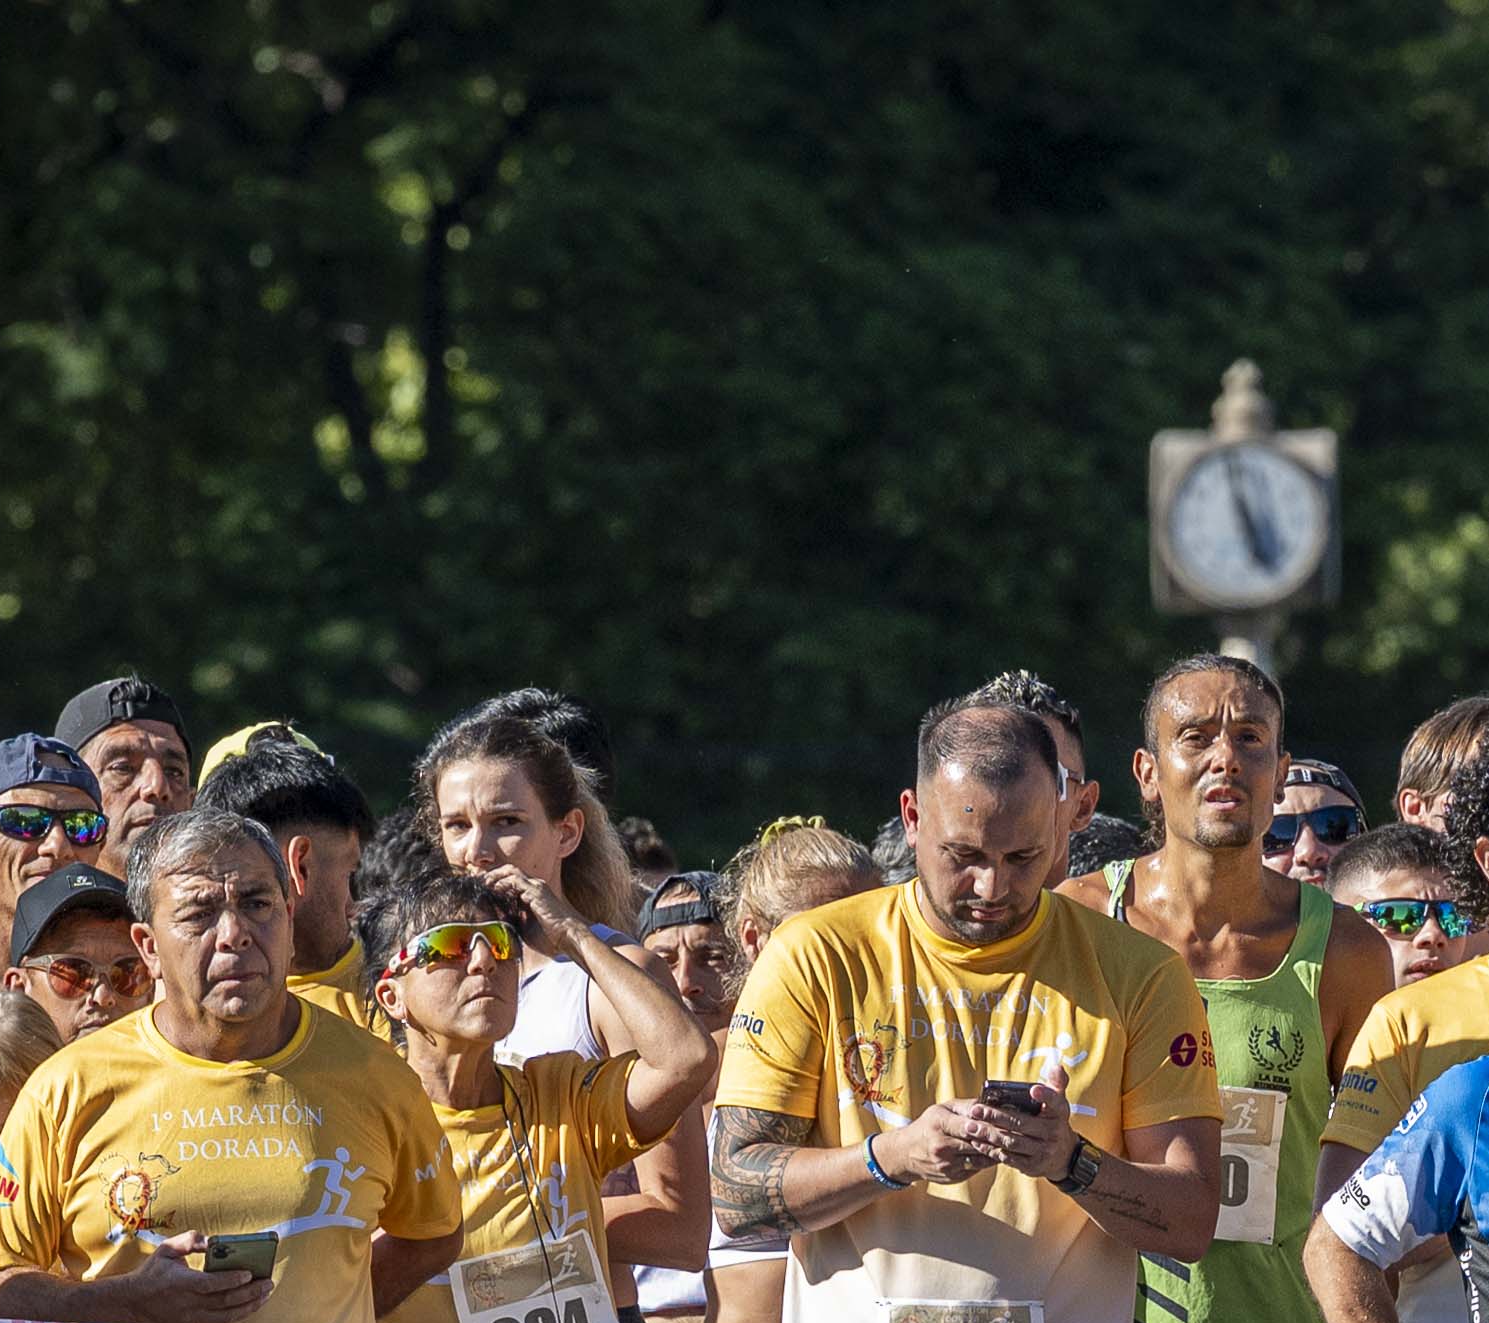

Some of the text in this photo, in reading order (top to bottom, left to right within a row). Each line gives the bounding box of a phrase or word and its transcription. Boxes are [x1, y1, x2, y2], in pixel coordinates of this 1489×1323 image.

[914, 985, 1050, 1017] MARATÓN
[911, 1018, 1020, 1048] DORADA
[181, 1099, 324, 1130] MARATÓN
[177, 1137, 303, 1163] DORADA
